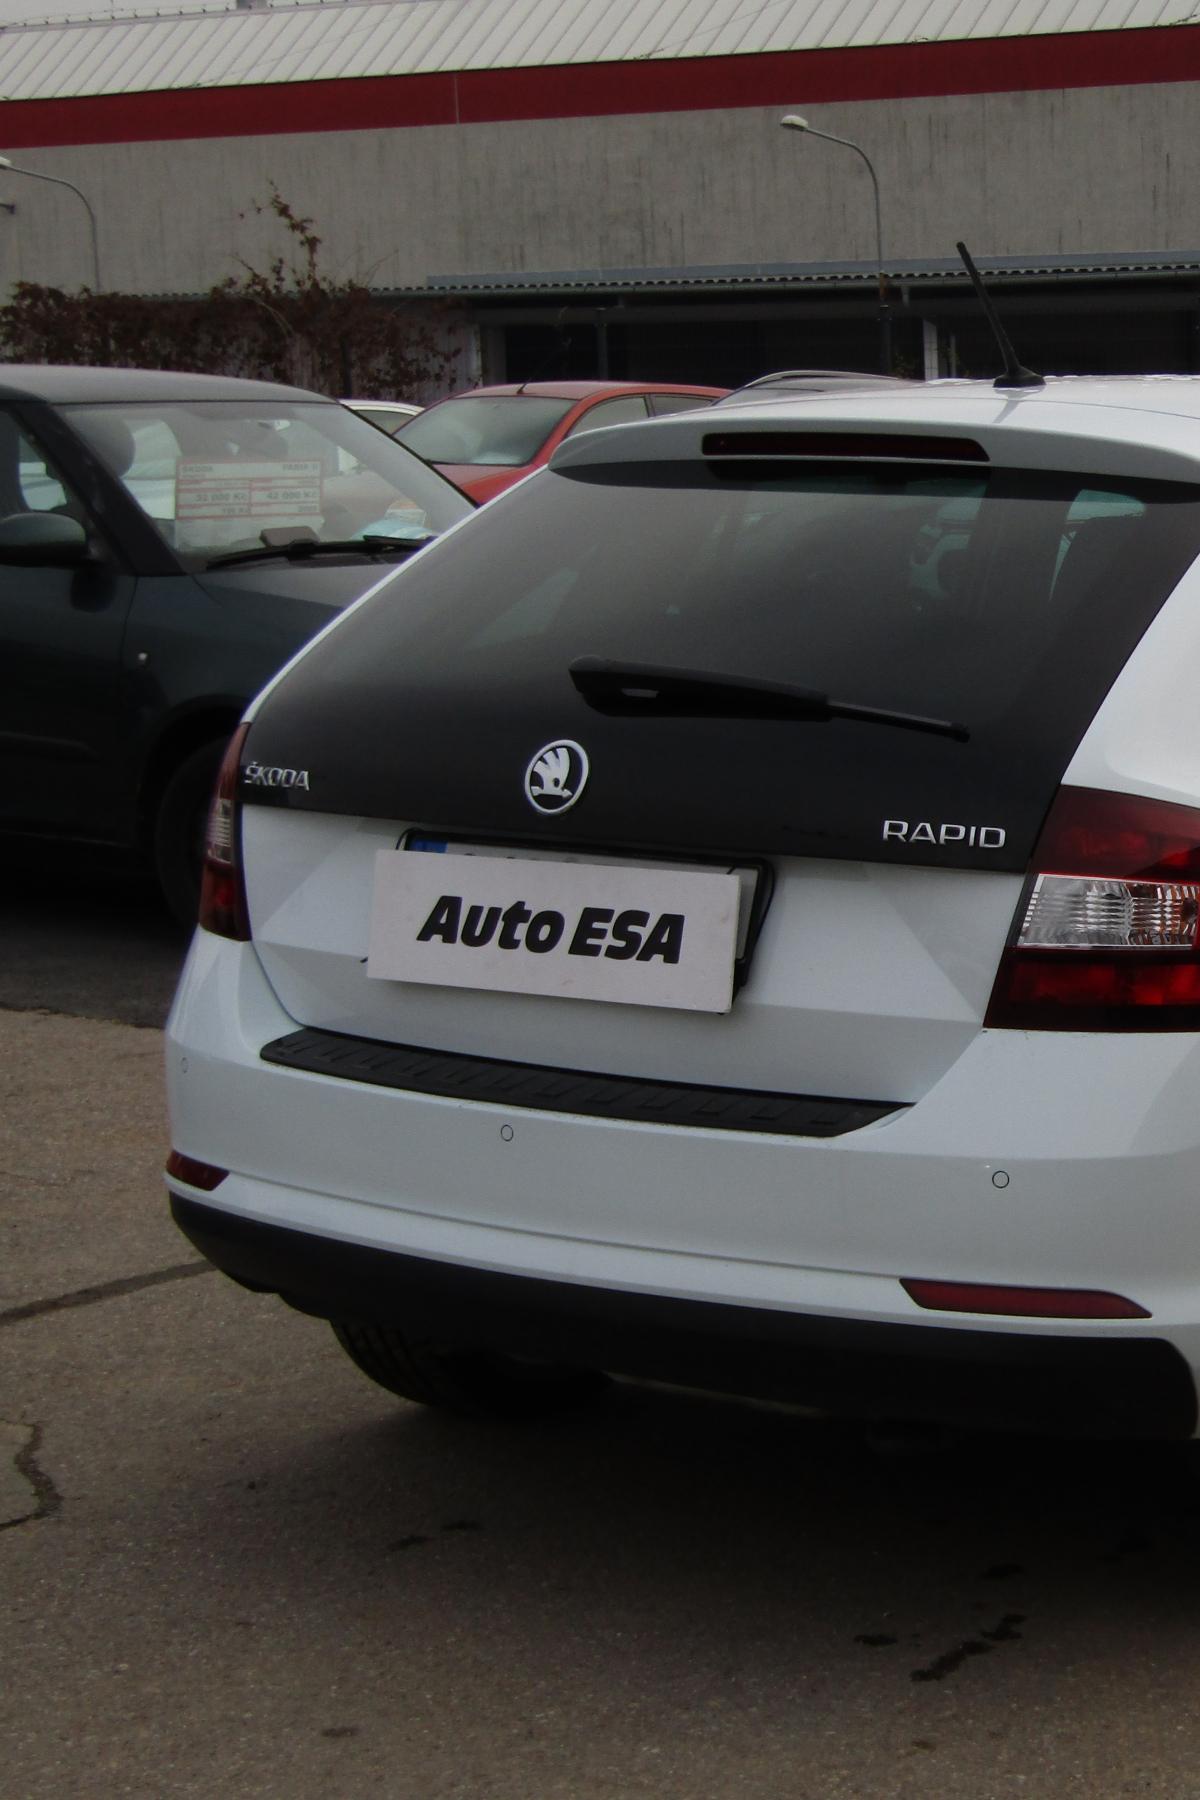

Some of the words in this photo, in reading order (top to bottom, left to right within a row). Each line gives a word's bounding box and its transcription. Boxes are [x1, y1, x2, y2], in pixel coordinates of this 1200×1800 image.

[244, 761, 310, 791] ŠKODA
[882, 819, 1006, 848] RAPID
[416, 895, 565, 953] Auto
[568, 906, 685, 964] ESA
